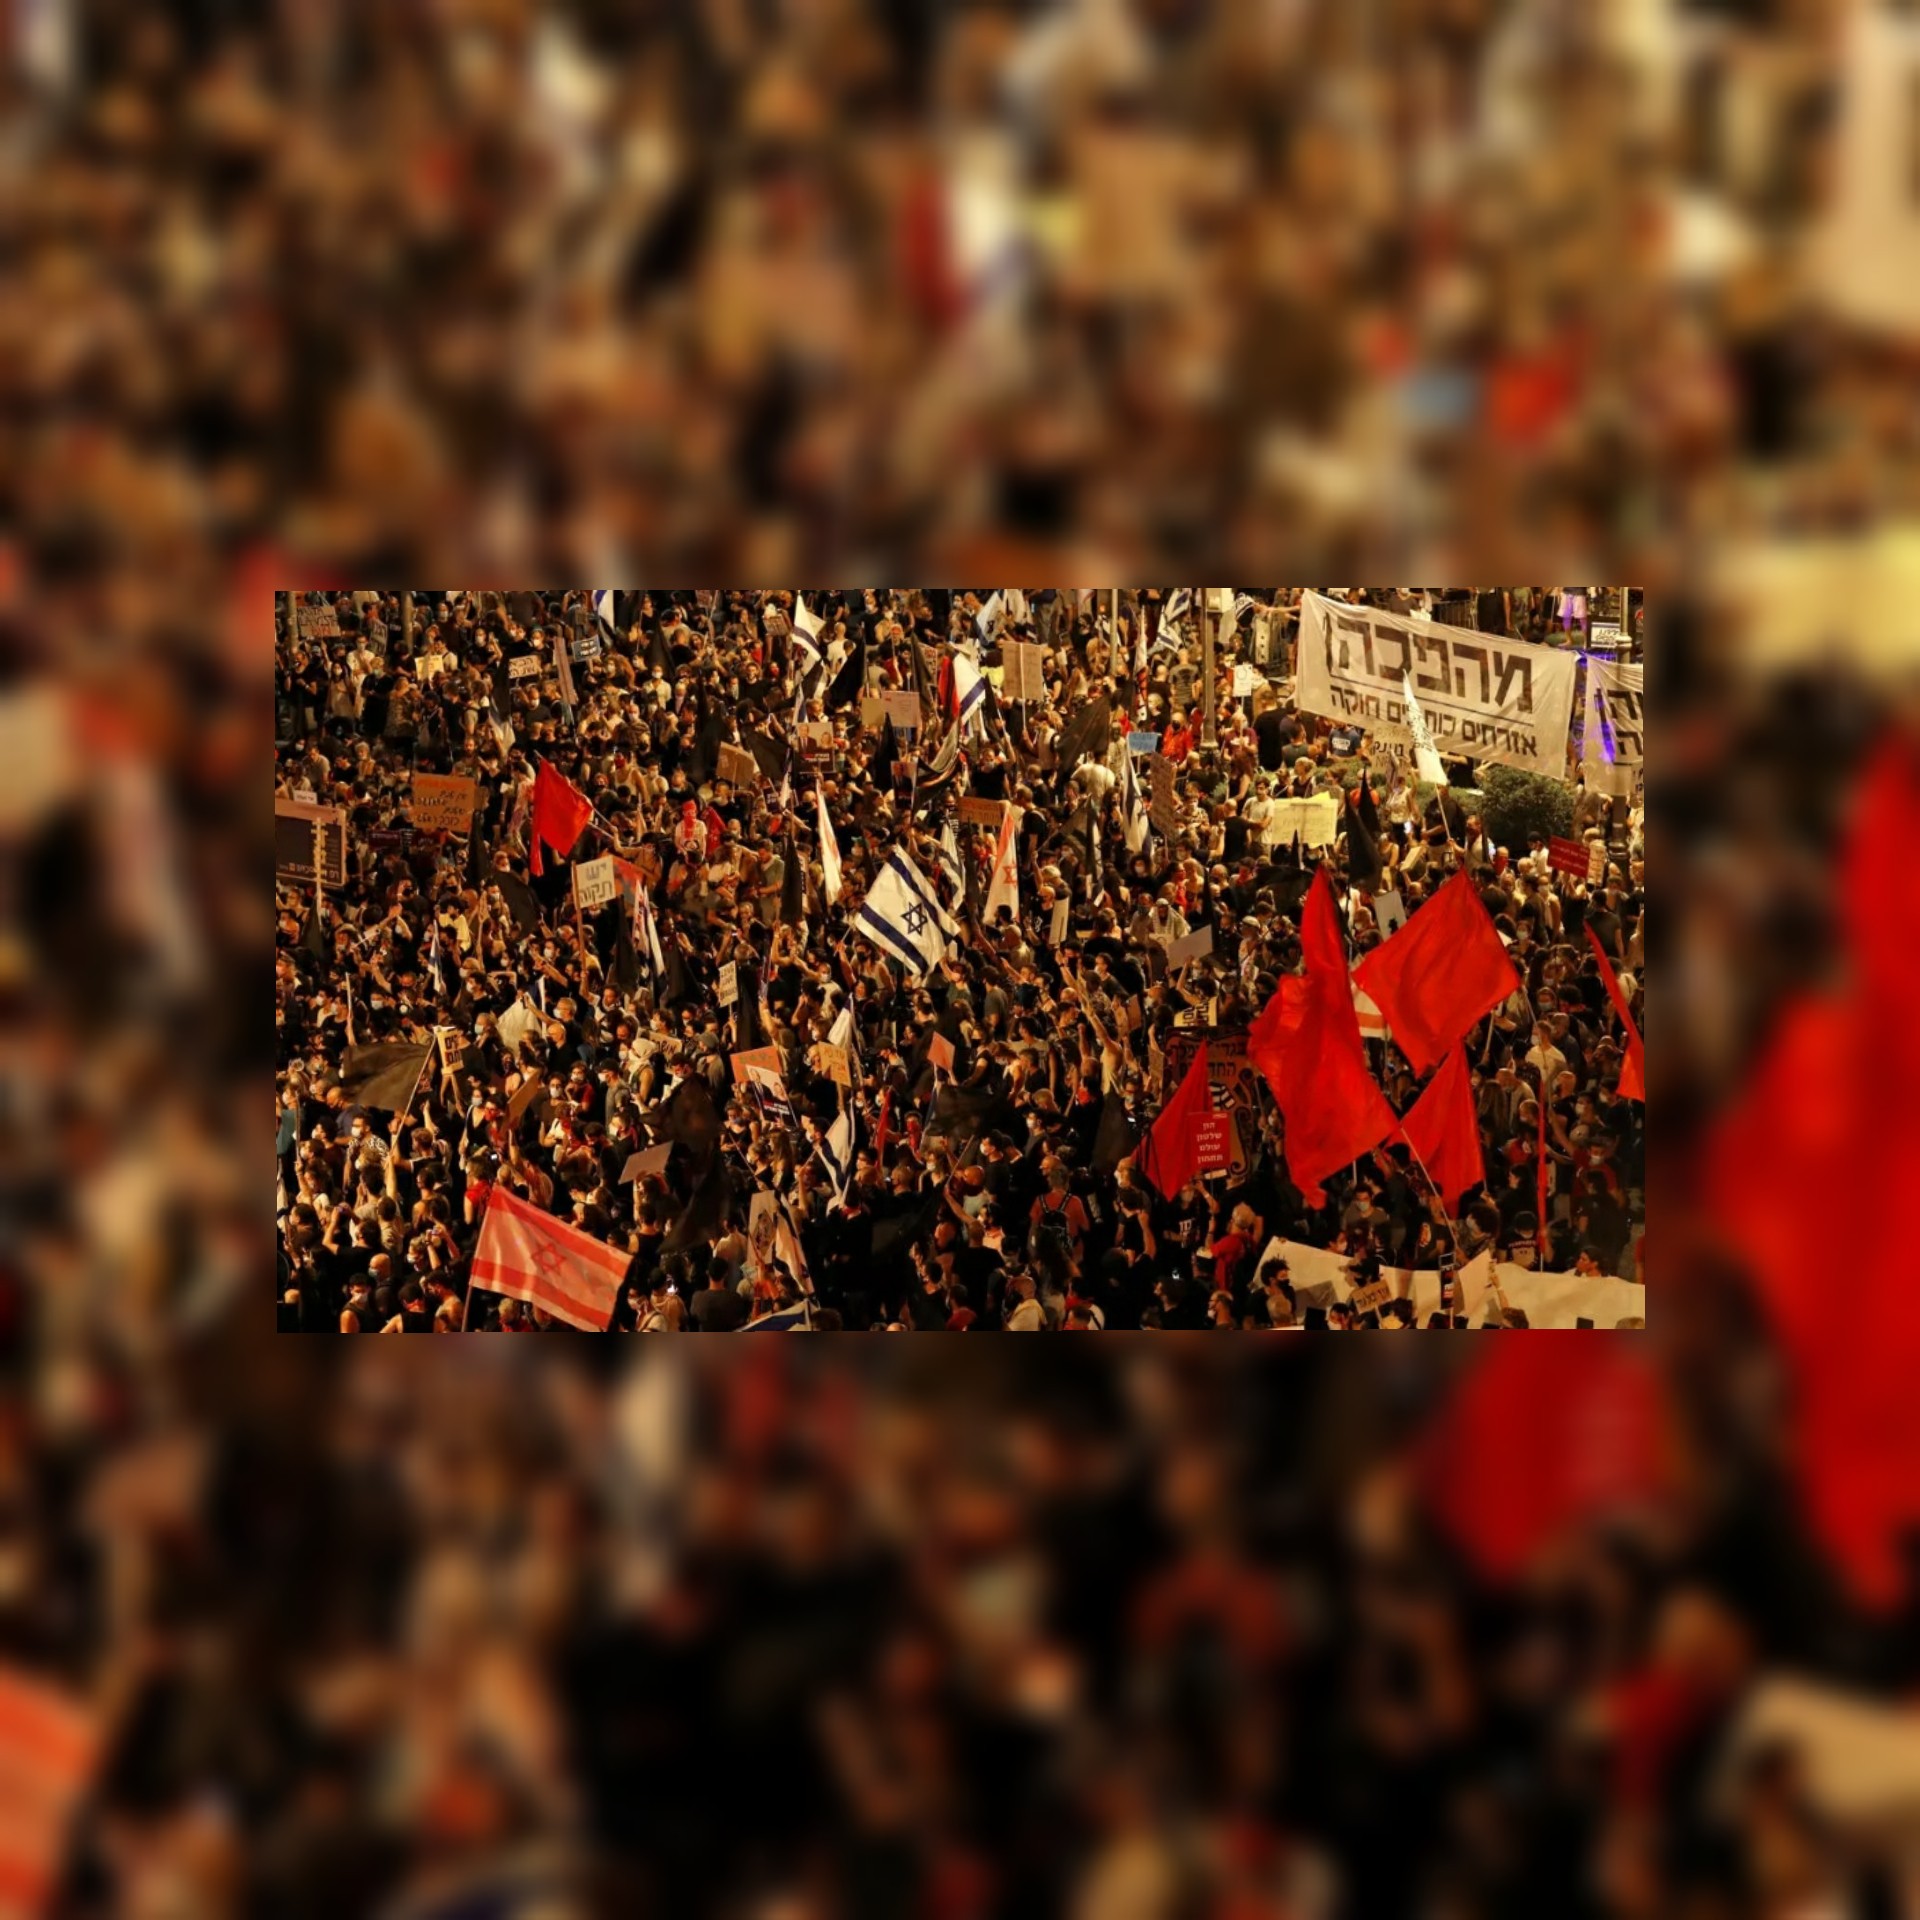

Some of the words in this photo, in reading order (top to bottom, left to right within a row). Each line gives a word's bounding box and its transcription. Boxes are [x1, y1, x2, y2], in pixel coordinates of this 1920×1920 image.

[1330, 684, 1380, 719] חוקה
[1387, 701, 1457, 738] כותים
[1462, 718, 1538, 758] אזרחים
[586, 863, 607, 881] יש
[1196, 1132, 1222, 1142] שלטון
[1202, 1122, 1216, 1131] הון
